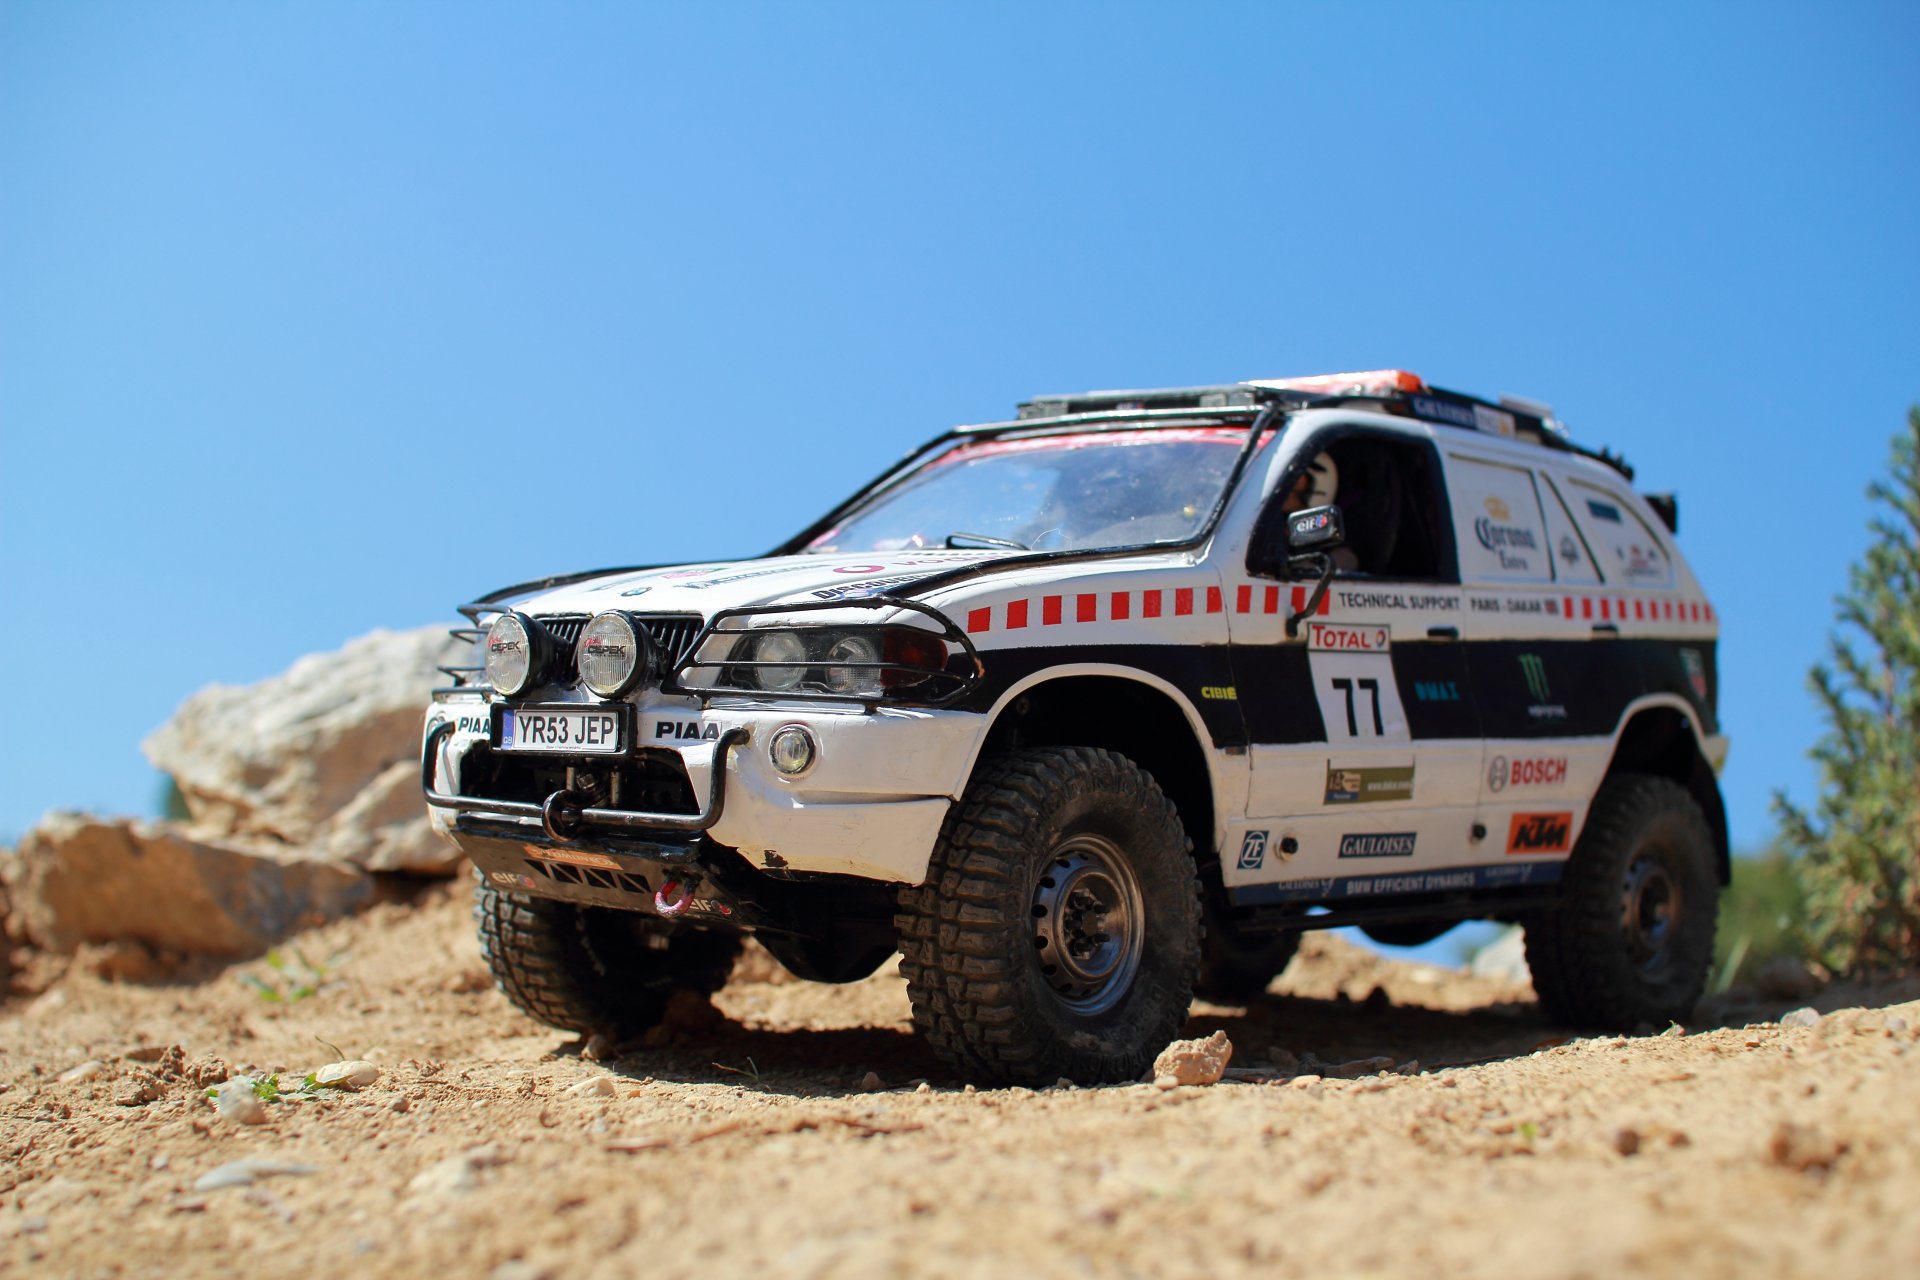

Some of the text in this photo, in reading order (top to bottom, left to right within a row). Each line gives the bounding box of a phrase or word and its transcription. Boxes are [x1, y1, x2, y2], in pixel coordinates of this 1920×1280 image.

[1296, 518, 1315, 532] elf
[1339, 592, 1460, 611] TECHNICAL SUPPORT
[1470, 597, 1500, 612] PARIS
[1312, 625, 1371, 648] TOTAL
[1201, 686, 1237, 700] CIBIE
[1331, 678, 1384, 736] 77
[458, 716, 490, 734] PIAA
[518, 714, 615, 746] YR53 JEP
[655, 721, 721, 740] PIAA
[1510, 757, 1567, 785] BOSCH
[1512, 816, 1567, 849] KTM
[1243, 839, 1263, 861] ZF
[1343, 833, 1414, 856] GAULOISES
[491, 871, 519, 885] elf
[1347, 879, 1371, 895] BMW
[1374, 875, 1424, 893] EFFICIENT
[1426, 871, 1475, 890] DYNAMICS
